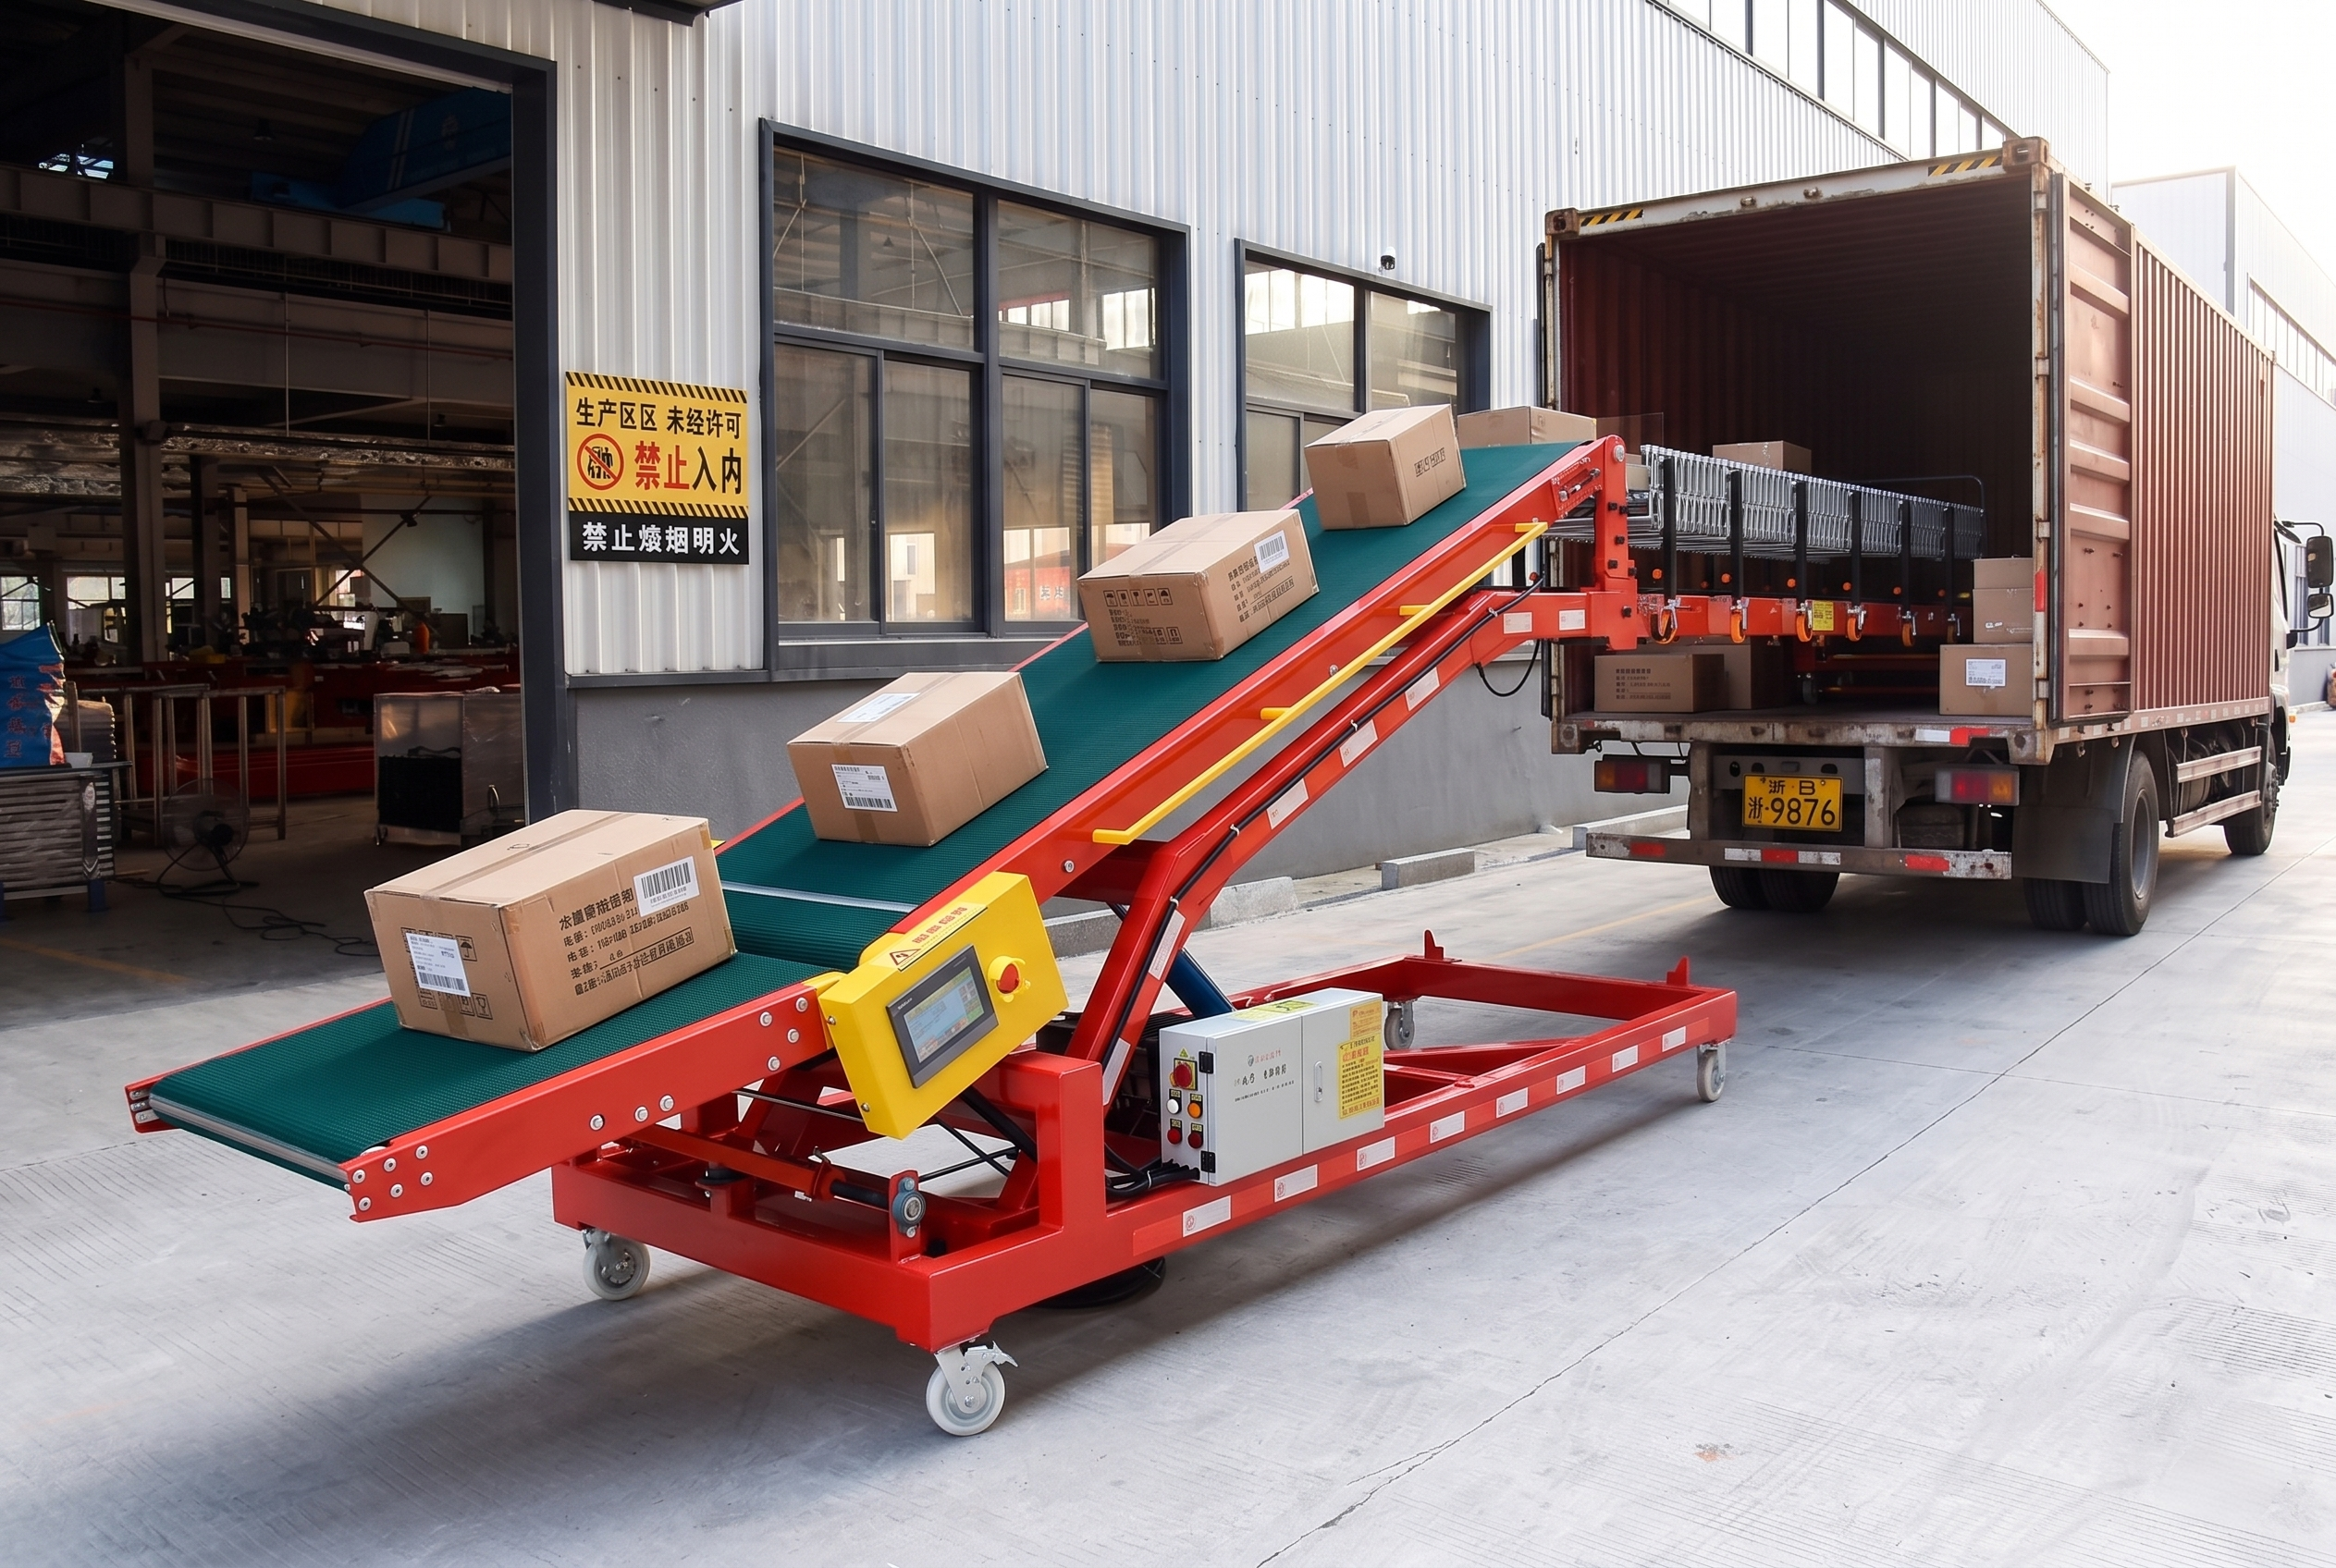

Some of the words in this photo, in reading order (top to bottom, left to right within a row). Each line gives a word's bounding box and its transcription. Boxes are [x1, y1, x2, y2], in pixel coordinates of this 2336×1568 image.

[576, 397, 658, 431] 生产区区
[667, 405, 742, 439] 未经许可
[634, 440, 743, 495] 禁止入内
